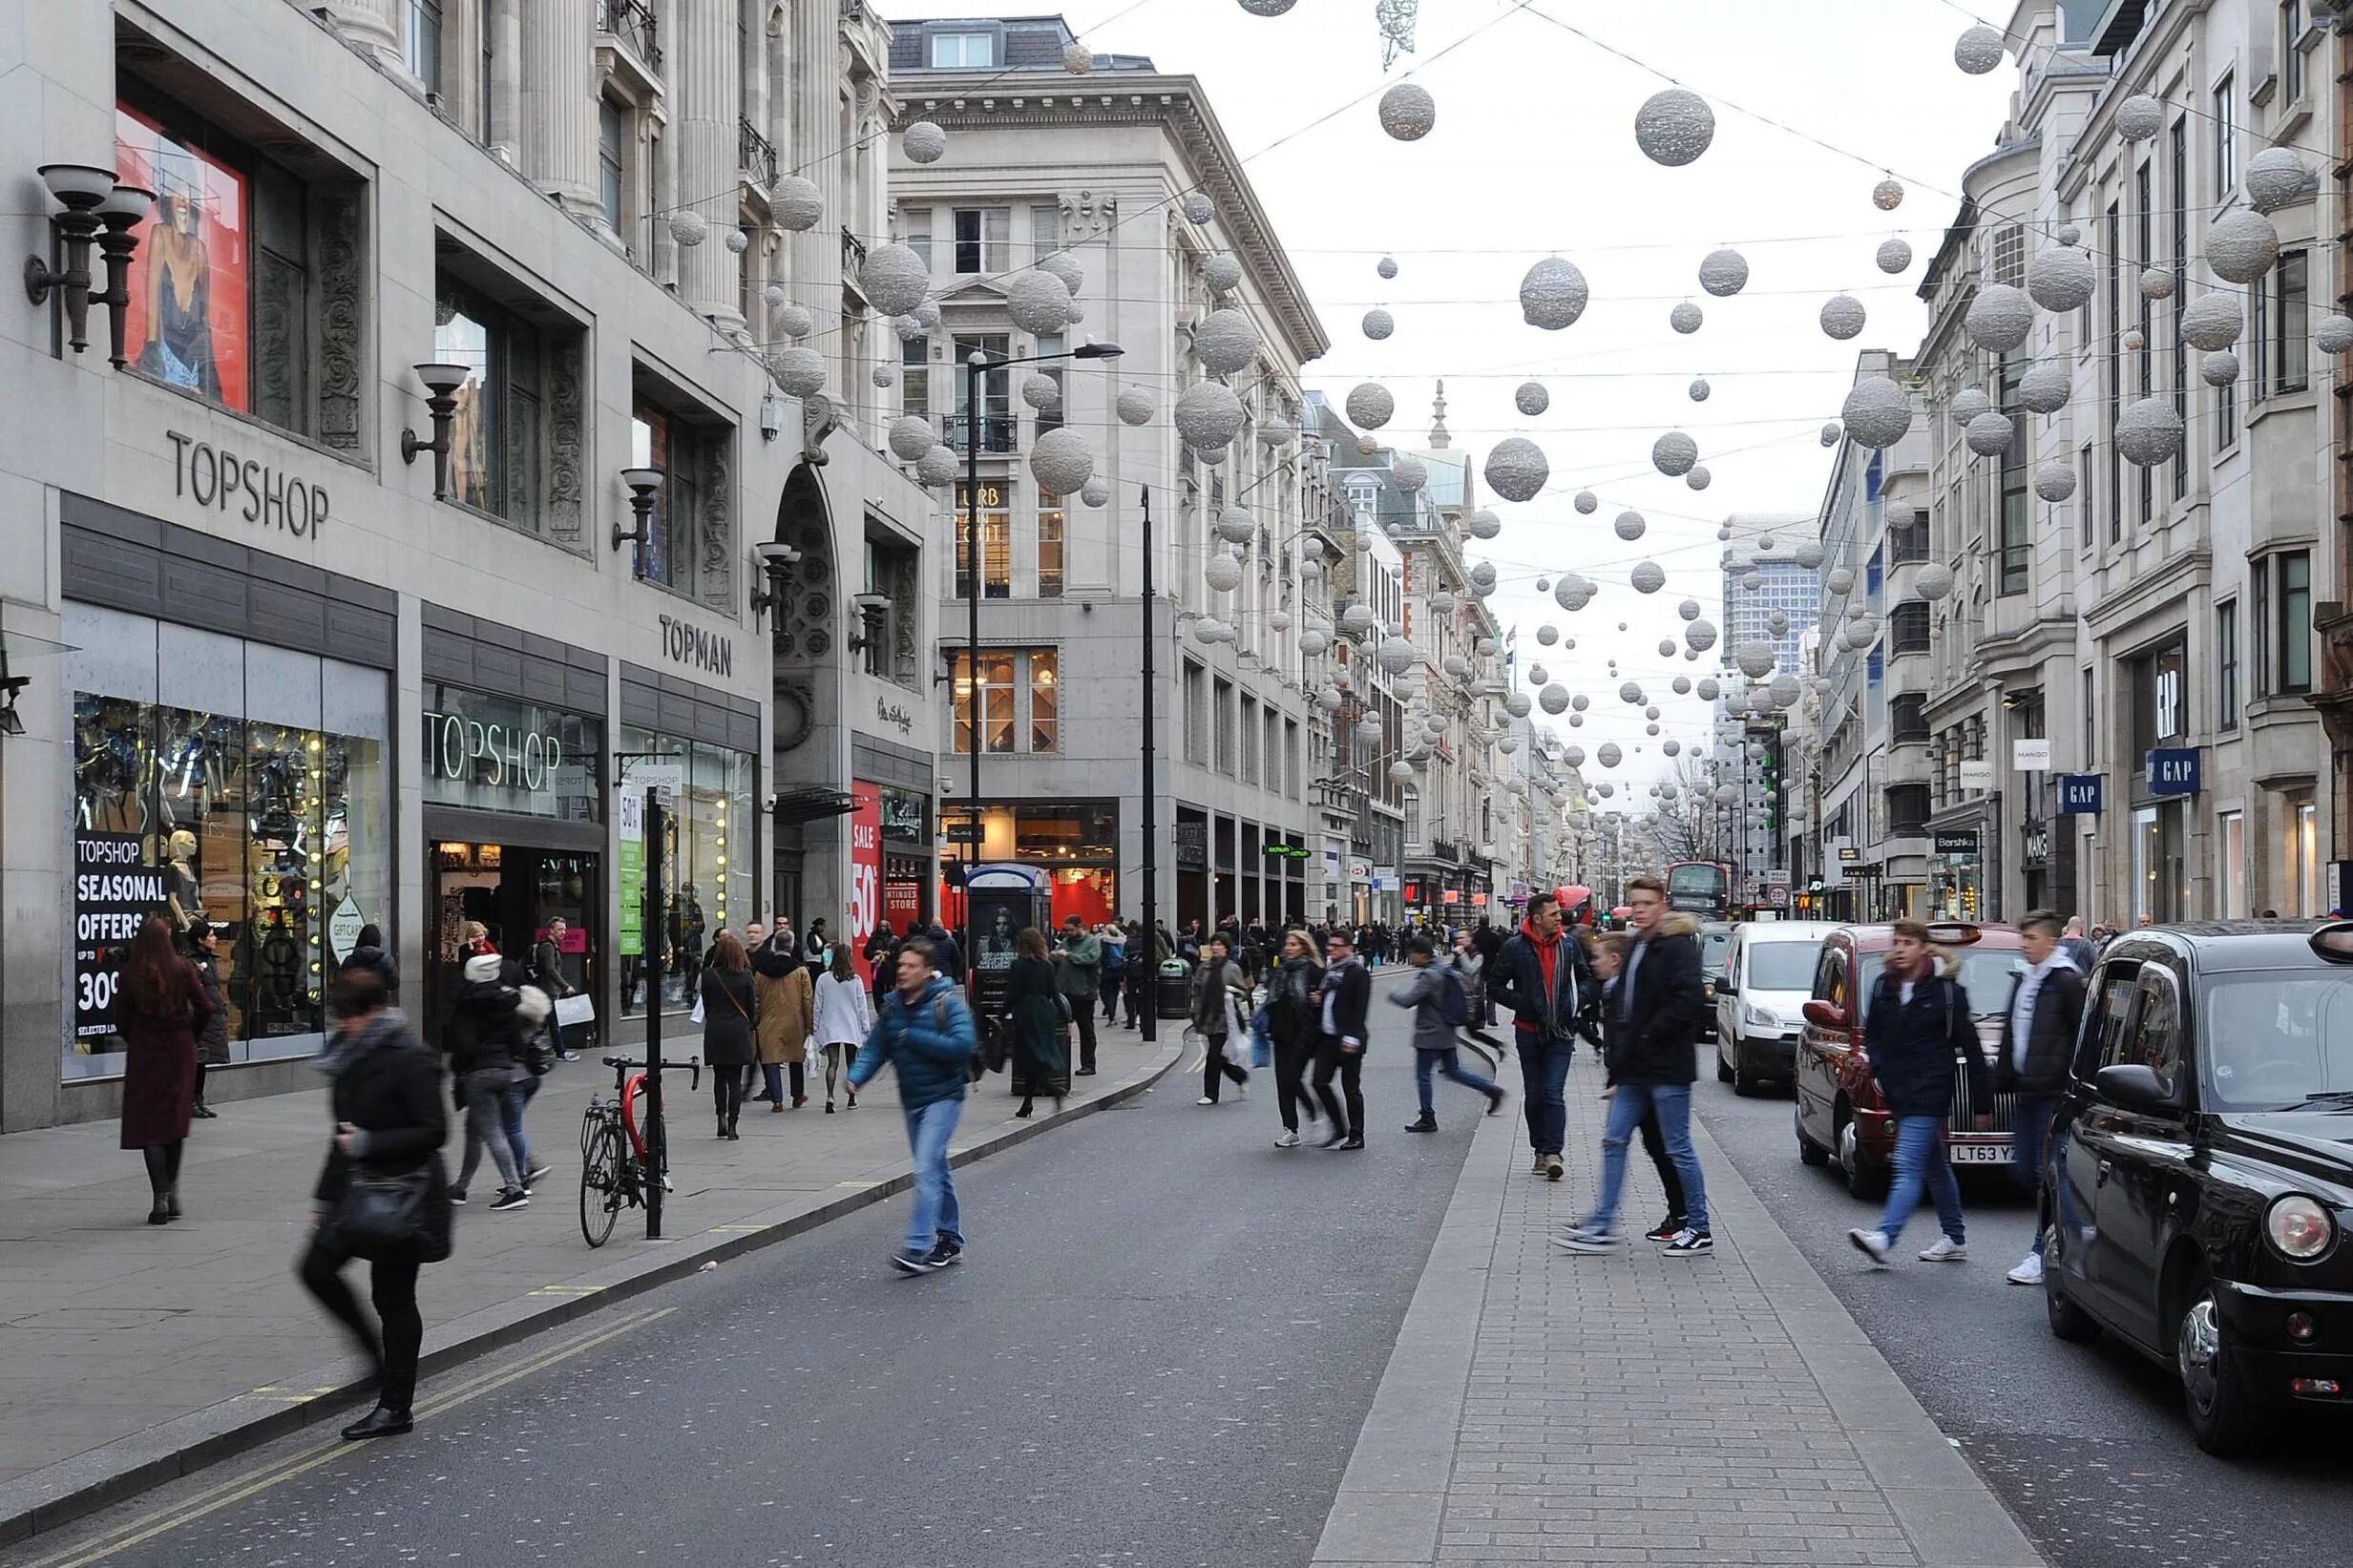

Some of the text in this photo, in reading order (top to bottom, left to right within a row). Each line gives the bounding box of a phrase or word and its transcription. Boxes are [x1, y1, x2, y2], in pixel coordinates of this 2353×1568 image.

[166, 429, 329, 540] TOPSHOP
[659, 614, 731, 679] TOPMAN
[423, 712, 561, 791] TOPSHOP
[634, 775, 679, 785] TOPSHOP
[2163, 761, 2192, 782] GAP
[2069, 785, 2095, 804] GAP
[853, 824, 874, 849] SALE
[1939, 837, 1975, 847] Bershka
[77, 840, 139, 864] TOPSHOP
[77, 874, 167, 902] SEASONAL
[1809, 881, 1822, 890] JD
[890, 900, 917, 909] STORE
[77, 913, 143, 941] OFFERS
[334, 924, 346, 936] GIFT
[78, 951, 95, 960] UP TO
[78, 1024, 106, 1035] SELECTED
[1957, 1146, 1996, 1160] LT63
